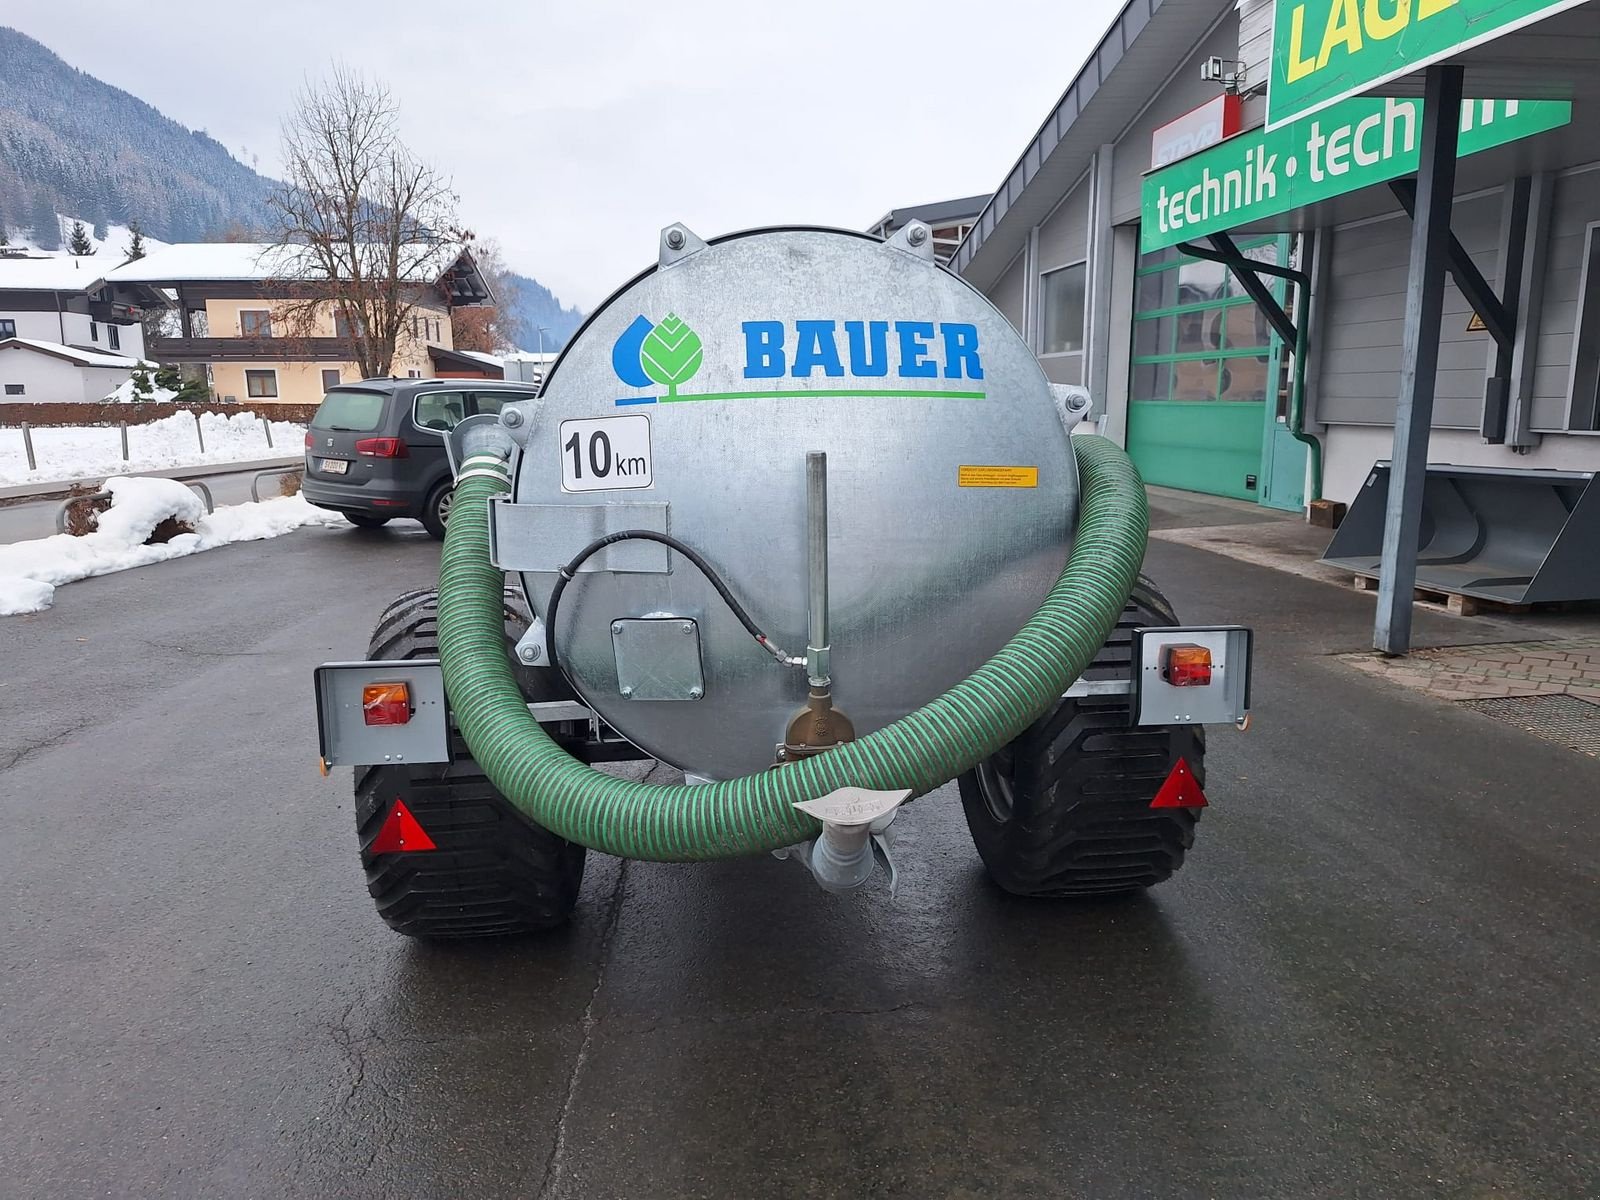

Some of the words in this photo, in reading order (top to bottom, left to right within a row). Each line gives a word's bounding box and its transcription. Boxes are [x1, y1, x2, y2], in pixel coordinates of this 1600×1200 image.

[1287, 0, 1460, 84] LAG
[1157, 144, 1276, 233] technik
[741, 320, 984, 380] BAUER
[565, 430, 612, 479] 10
[616, 453, 646, 476] km
